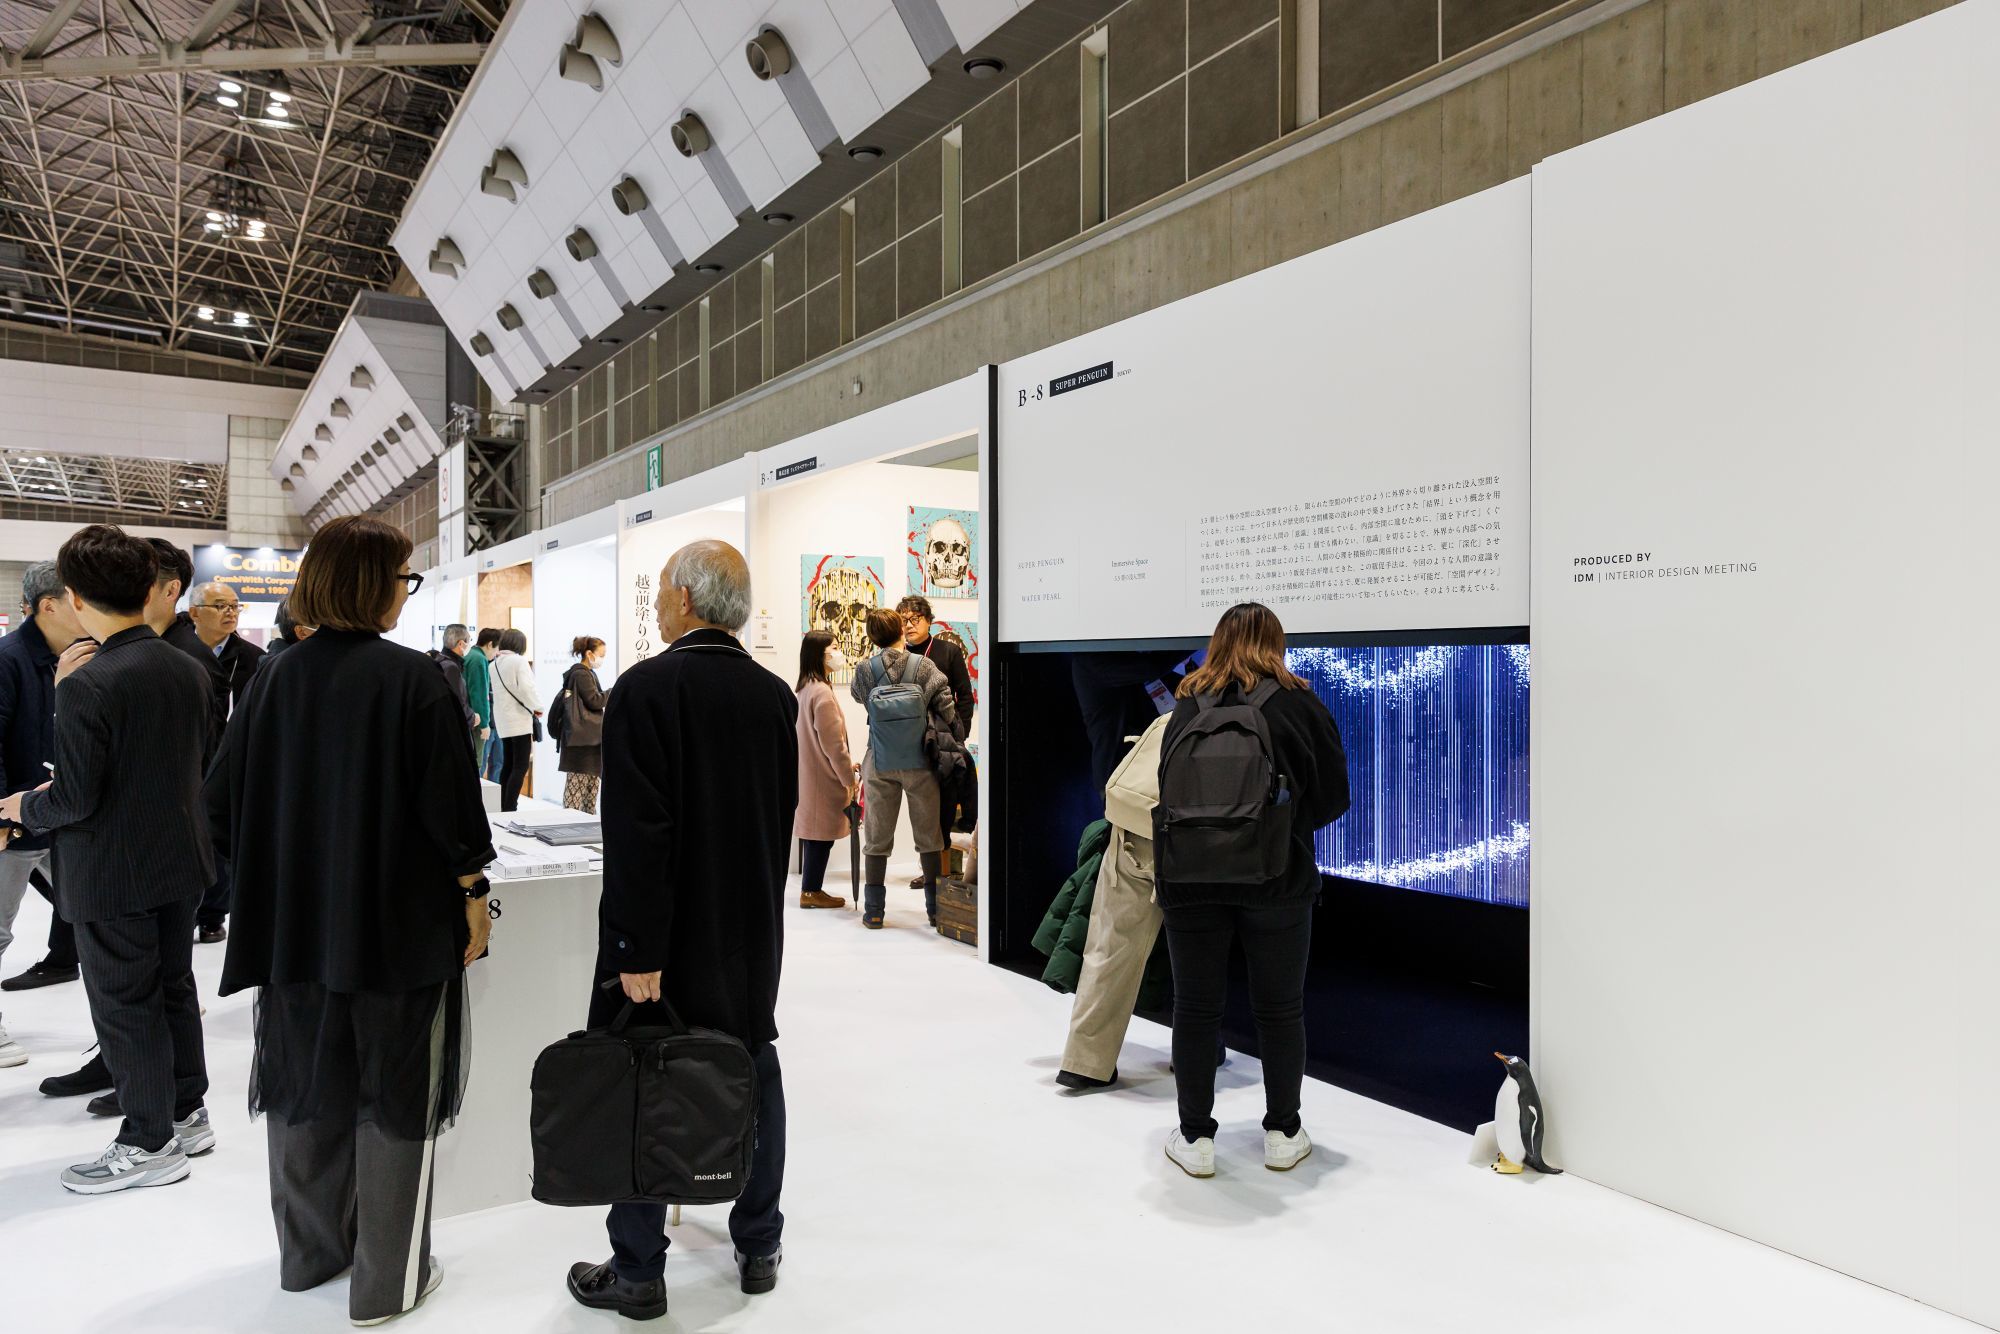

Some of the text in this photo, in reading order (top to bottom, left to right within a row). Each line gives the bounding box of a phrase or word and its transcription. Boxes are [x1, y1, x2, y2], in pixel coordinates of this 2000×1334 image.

[1055, 378, 1076, 391] SUPER
[1078, 367, 1108, 384] PENGUIN
[1037, 558, 1064, 567] PENGUIN
[1574, 553, 1651, 566] PRODUCED BY
[1574, 573, 1594, 582] IDM
[1605, 570, 1654, 581] INTERIOR
[1658, 566, 1699, 578] DESIGN
[1704, 563, 1757, 574] MEETING
[213, 575, 264, 584] CombiWith
[241, 585, 266, 594] since
[1043, 592, 1061, 600] PEARL
